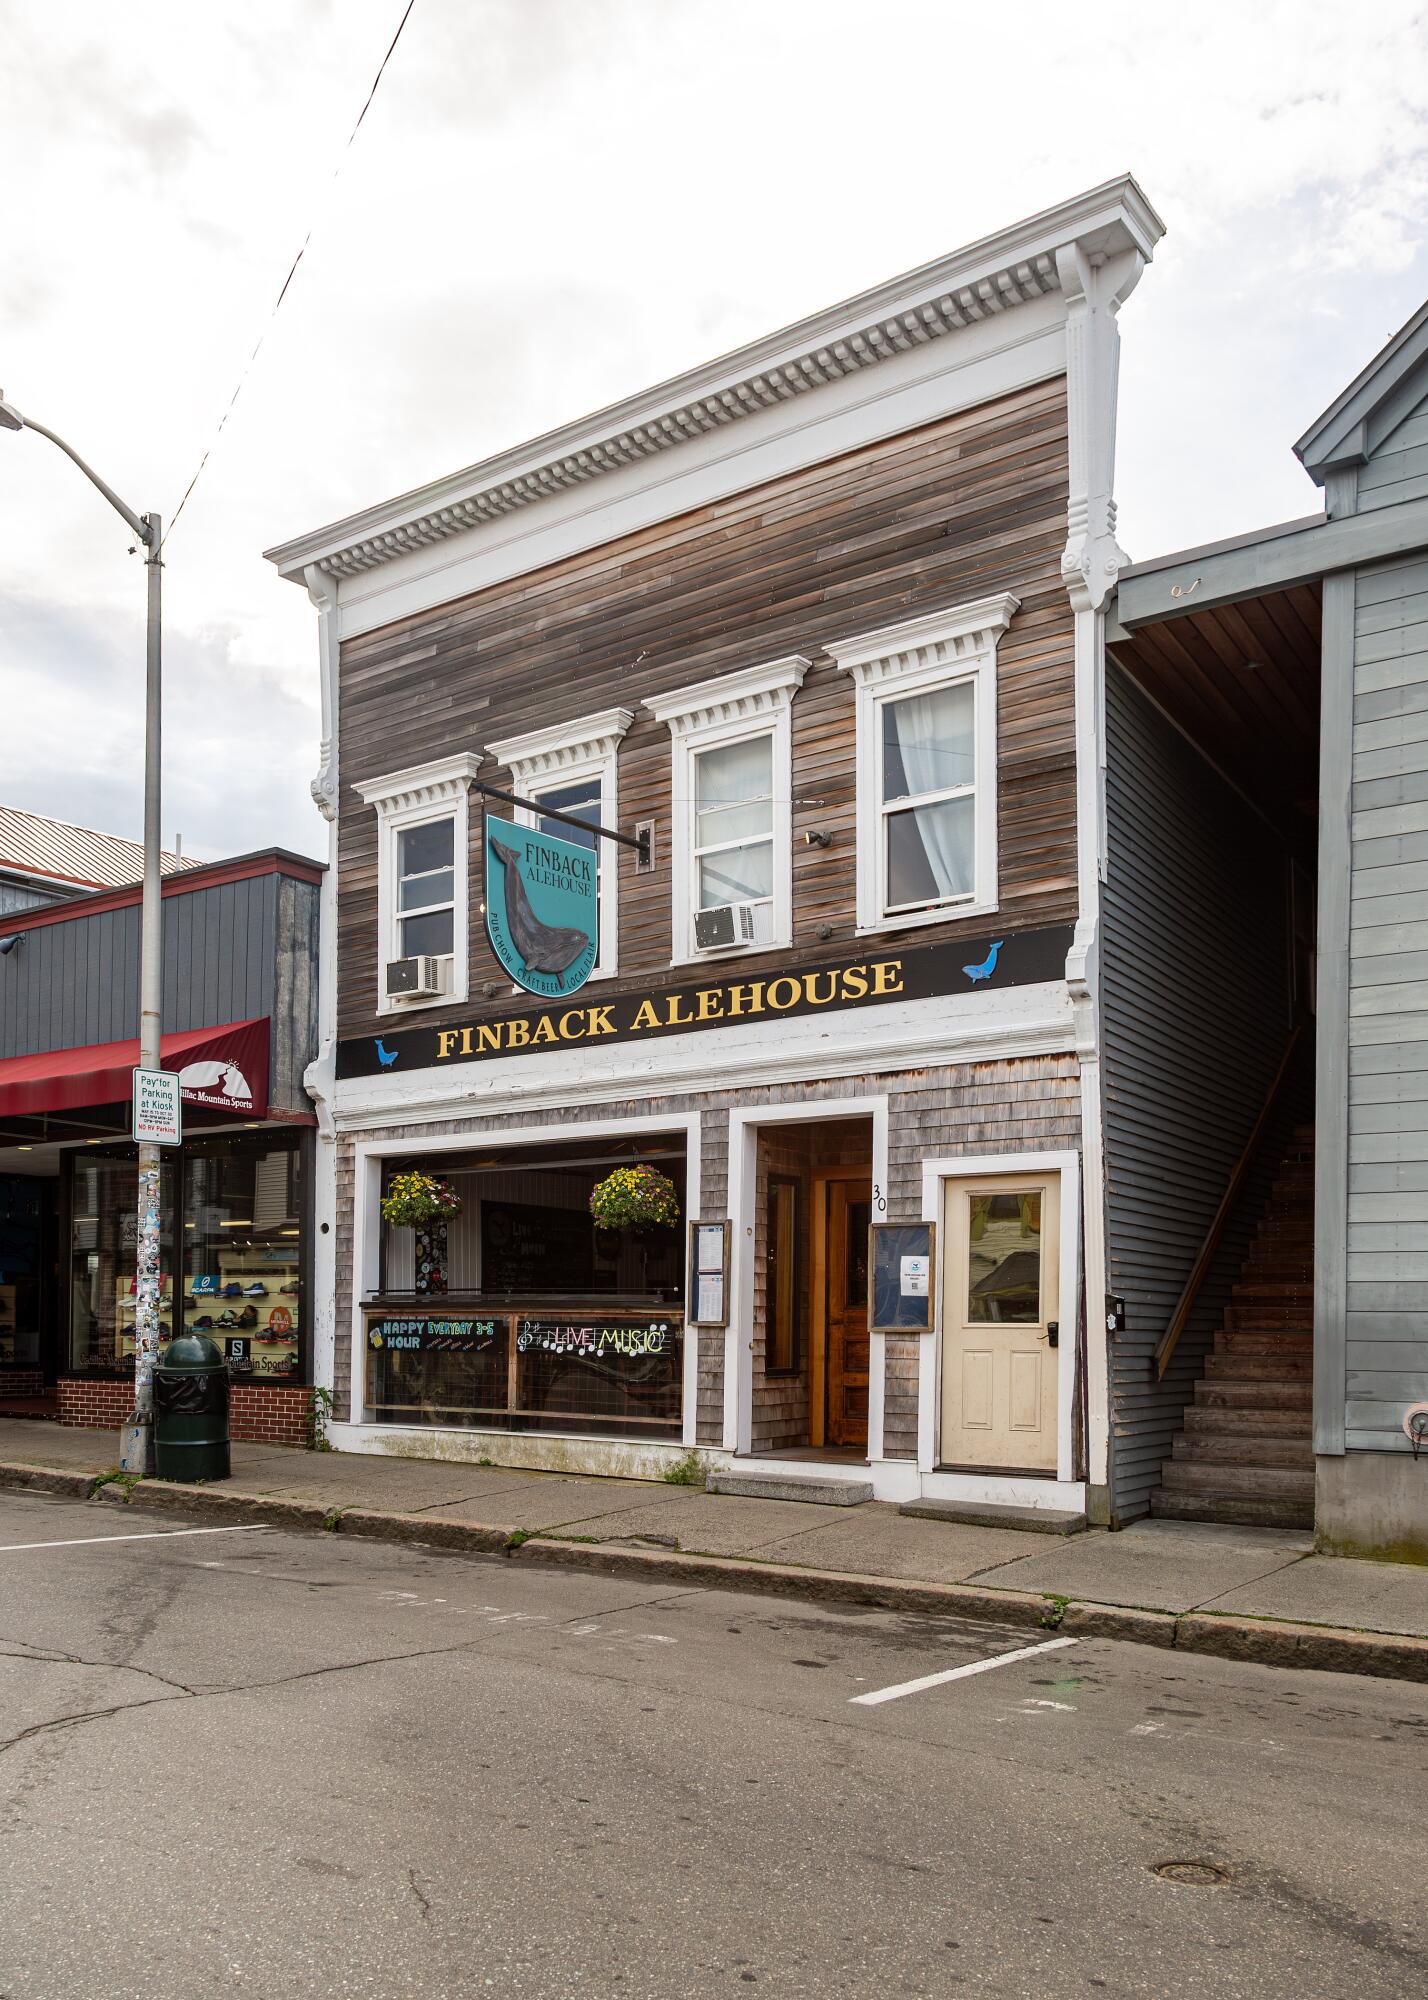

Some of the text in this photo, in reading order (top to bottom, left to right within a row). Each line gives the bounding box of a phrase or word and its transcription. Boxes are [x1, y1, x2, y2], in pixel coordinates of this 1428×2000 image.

[525, 842, 591, 881] FINBACK
[526, 867, 592, 898] ALEHOUSE
[490, 912, 513, 964] PUB CHOW
[567, 941, 595, 989] LOCAL FLAIR
[517, 967, 560, 993] CRAFT BEER
[436, 960, 904, 1058] FINBACK ALEHOUSE
[141, 1075, 171, 1088] Pay for
[141, 1087, 173, 1102] Parking
[141, 1100, 174, 1111] at Kiosk
[197, 1090, 231, 1106] Mountain
[231, 1097, 253, 1109] Sports
[156, 1125, 176, 1134] Parking
[873, 1184, 887, 1212] 30
[383, 1321, 494, 1336] HAPPY EVERYDAY 3-5
[554, 1326, 663, 1353] LIVE MUSIC
[387, 1335, 420, 1349] HOUR
[261, 1356, 289, 1372] Sports
